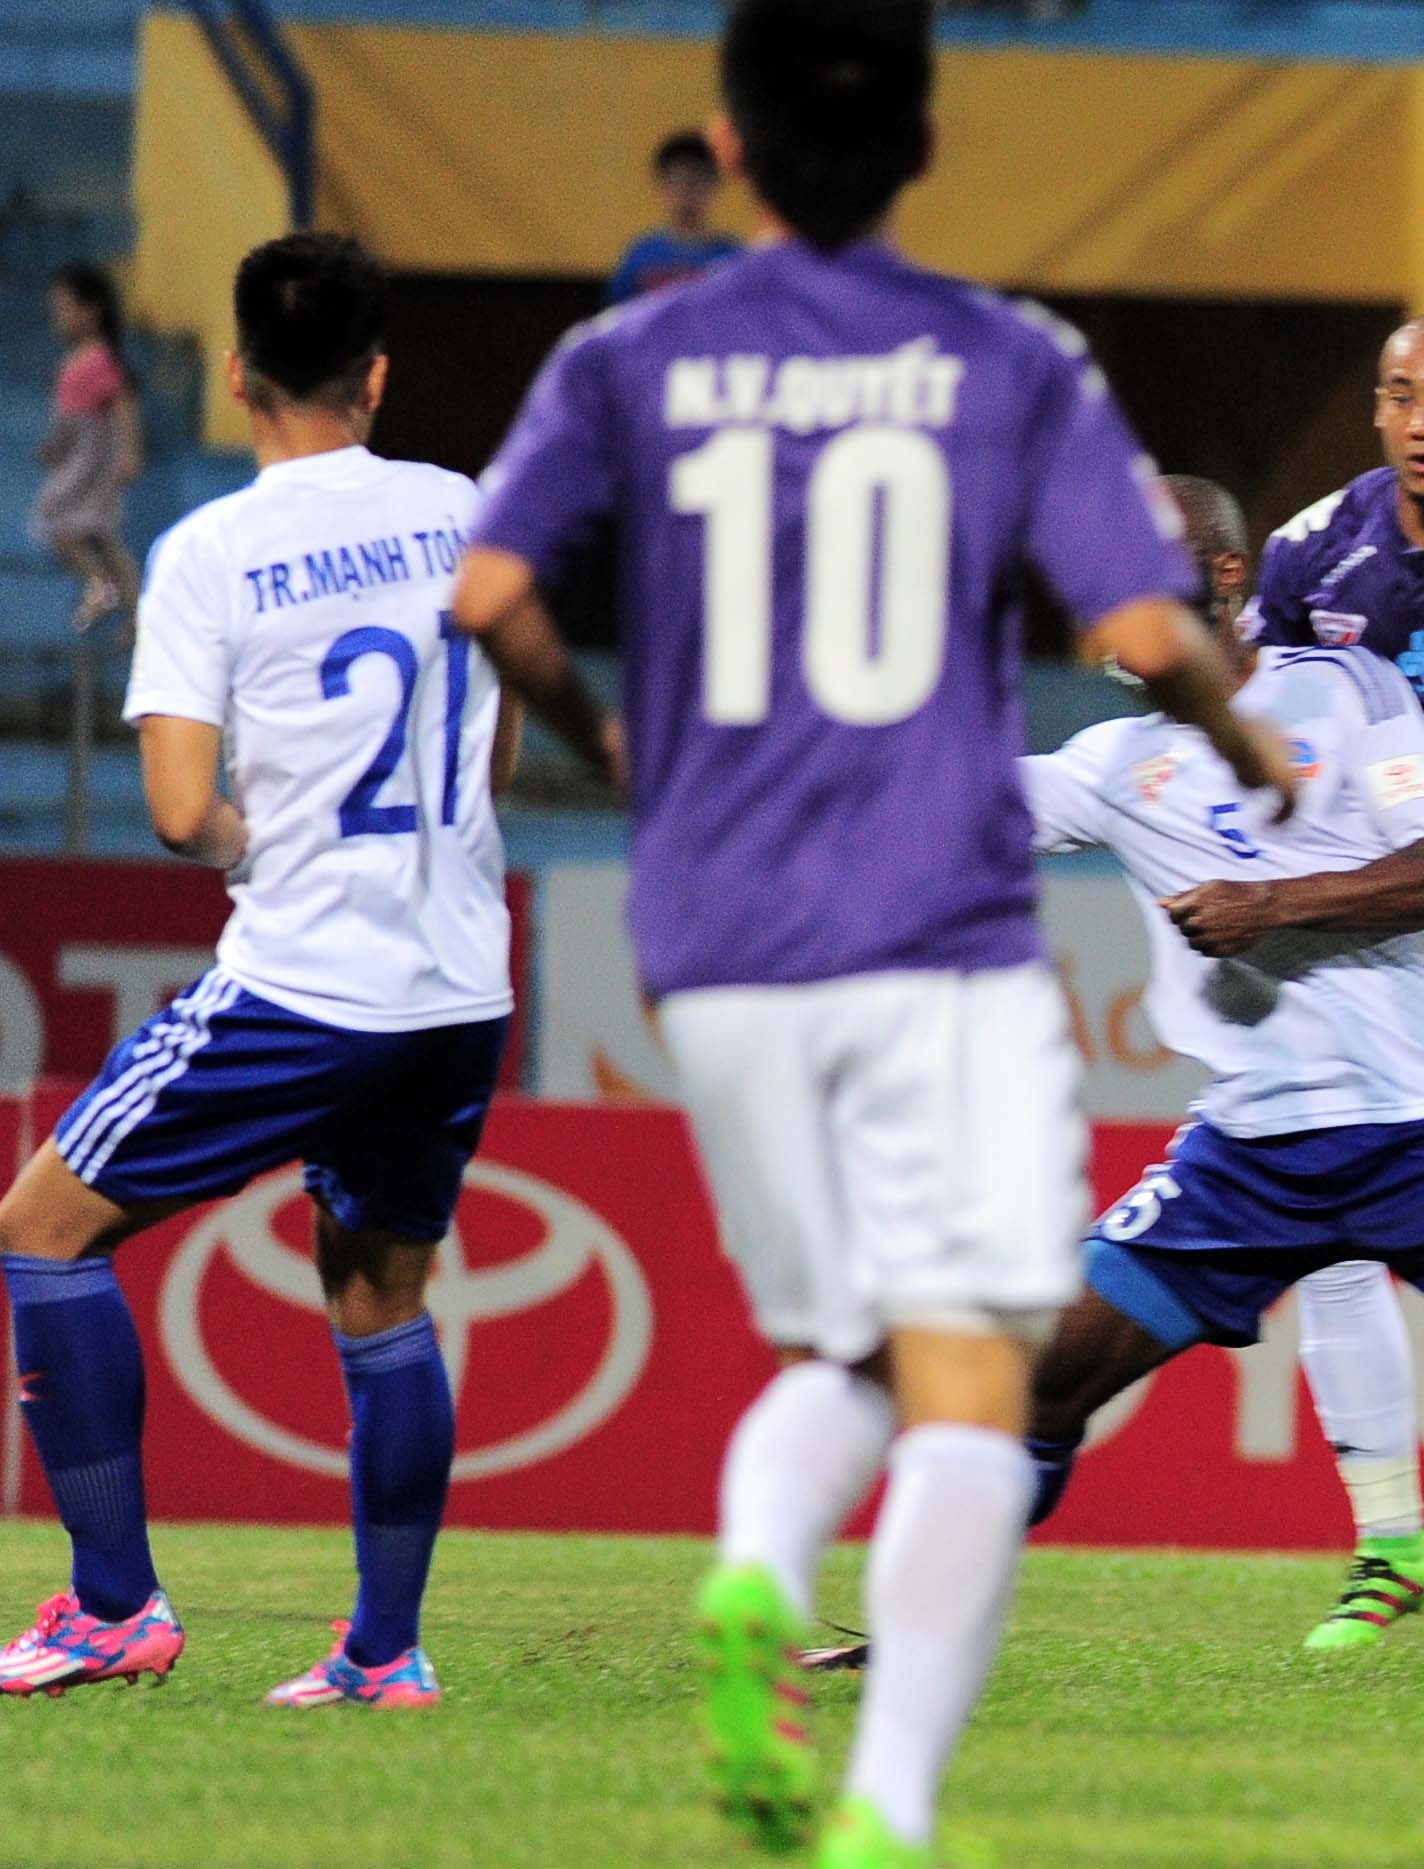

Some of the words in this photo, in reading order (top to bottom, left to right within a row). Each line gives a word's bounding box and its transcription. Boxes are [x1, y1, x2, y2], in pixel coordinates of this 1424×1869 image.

[246, 536, 410, 613] TR.MẠNH
[668, 426, 952, 727] 10
[319, 610, 471, 839] 21
[1206, 802, 1262, 860] 5
[1100, 1176, 1182, 1241] 5
